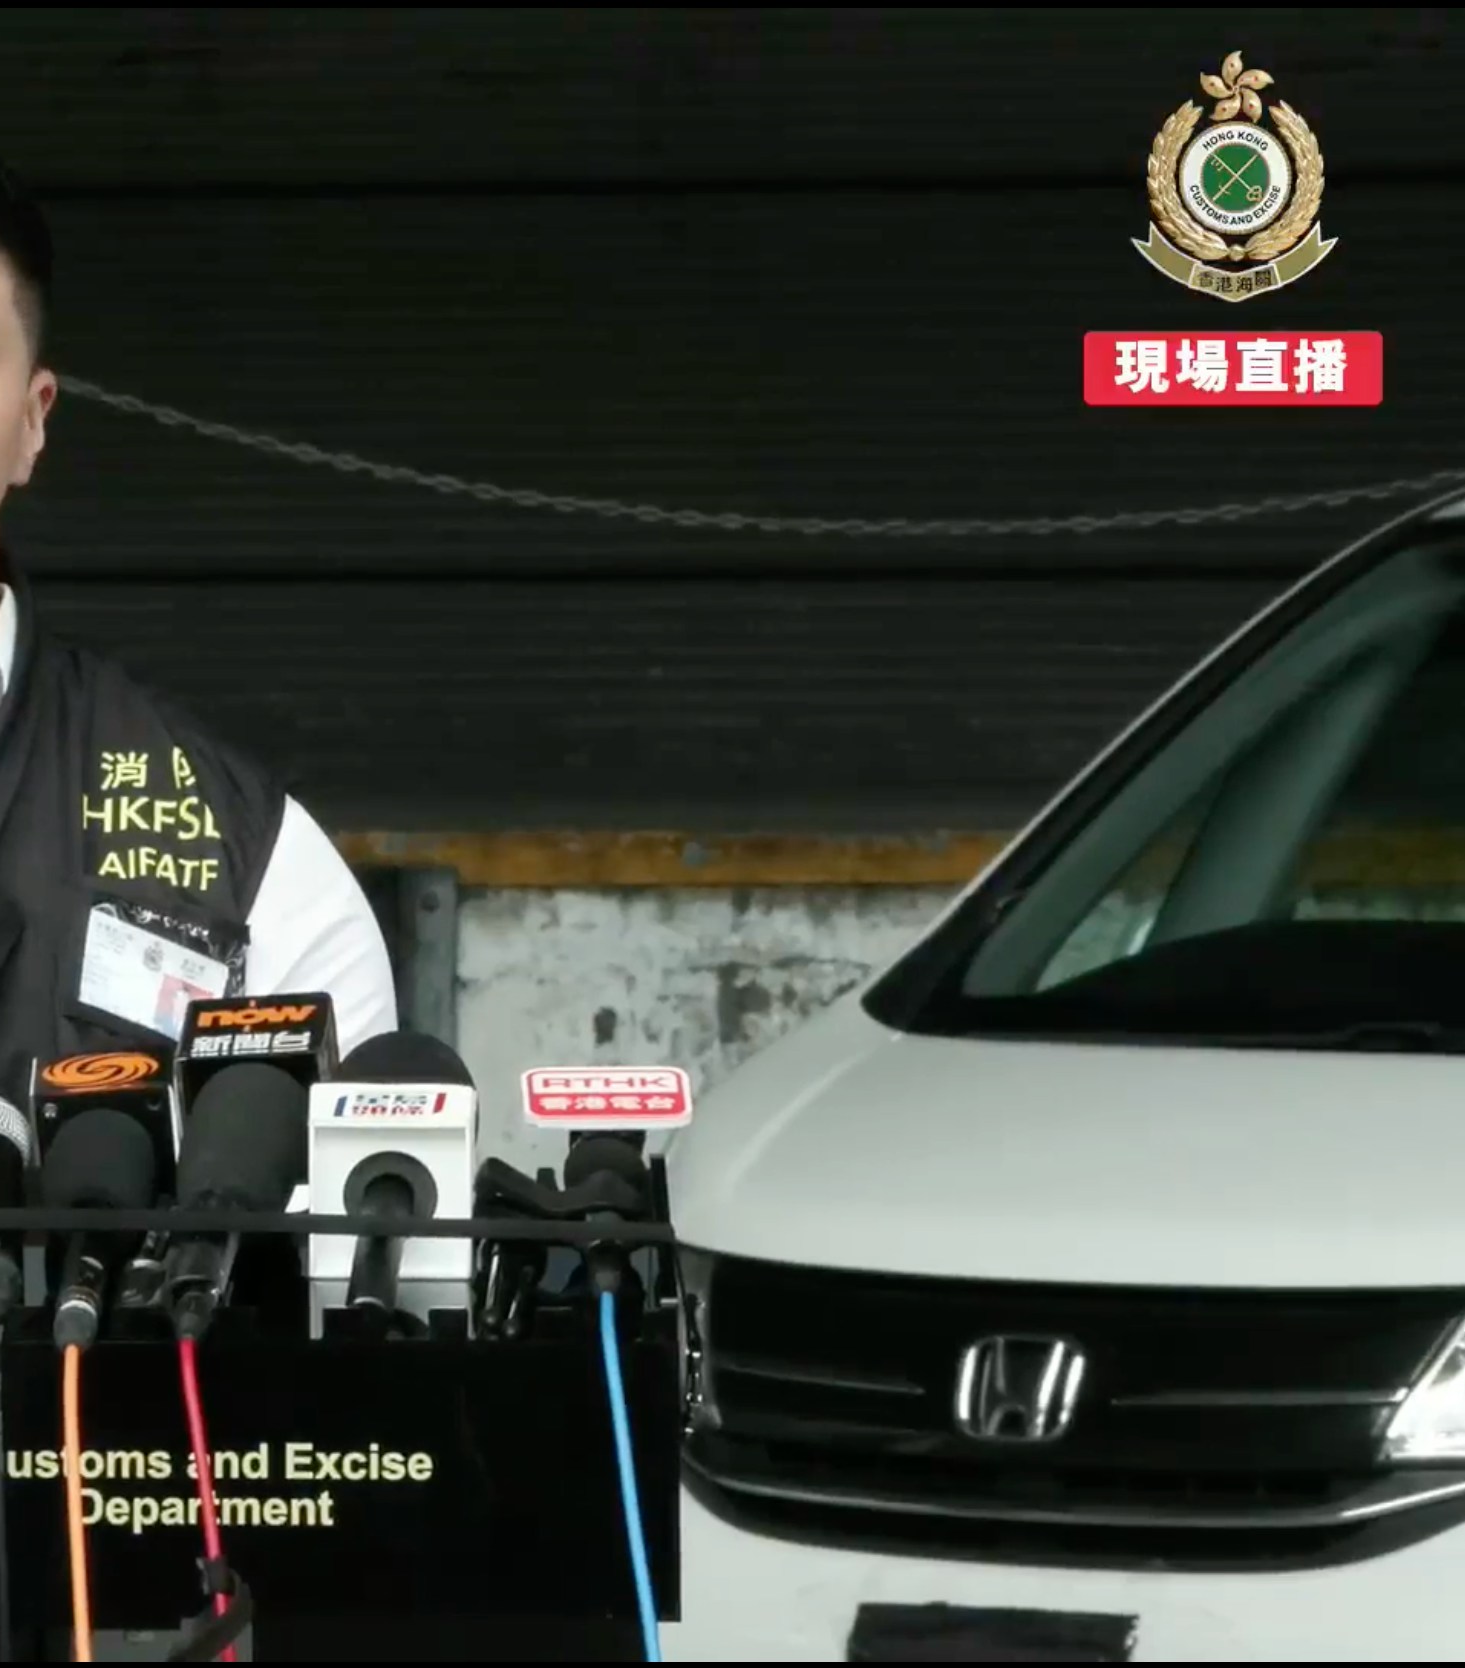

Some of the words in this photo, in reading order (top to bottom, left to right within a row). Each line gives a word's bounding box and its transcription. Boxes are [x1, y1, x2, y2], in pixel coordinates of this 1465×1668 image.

[98, 846, 219, 891] AIFATF
[197, 1004, 316, 1029] now
[542, 1076, 670, 1089] RTHK
[285, 1442, 434, 1480] Excise
